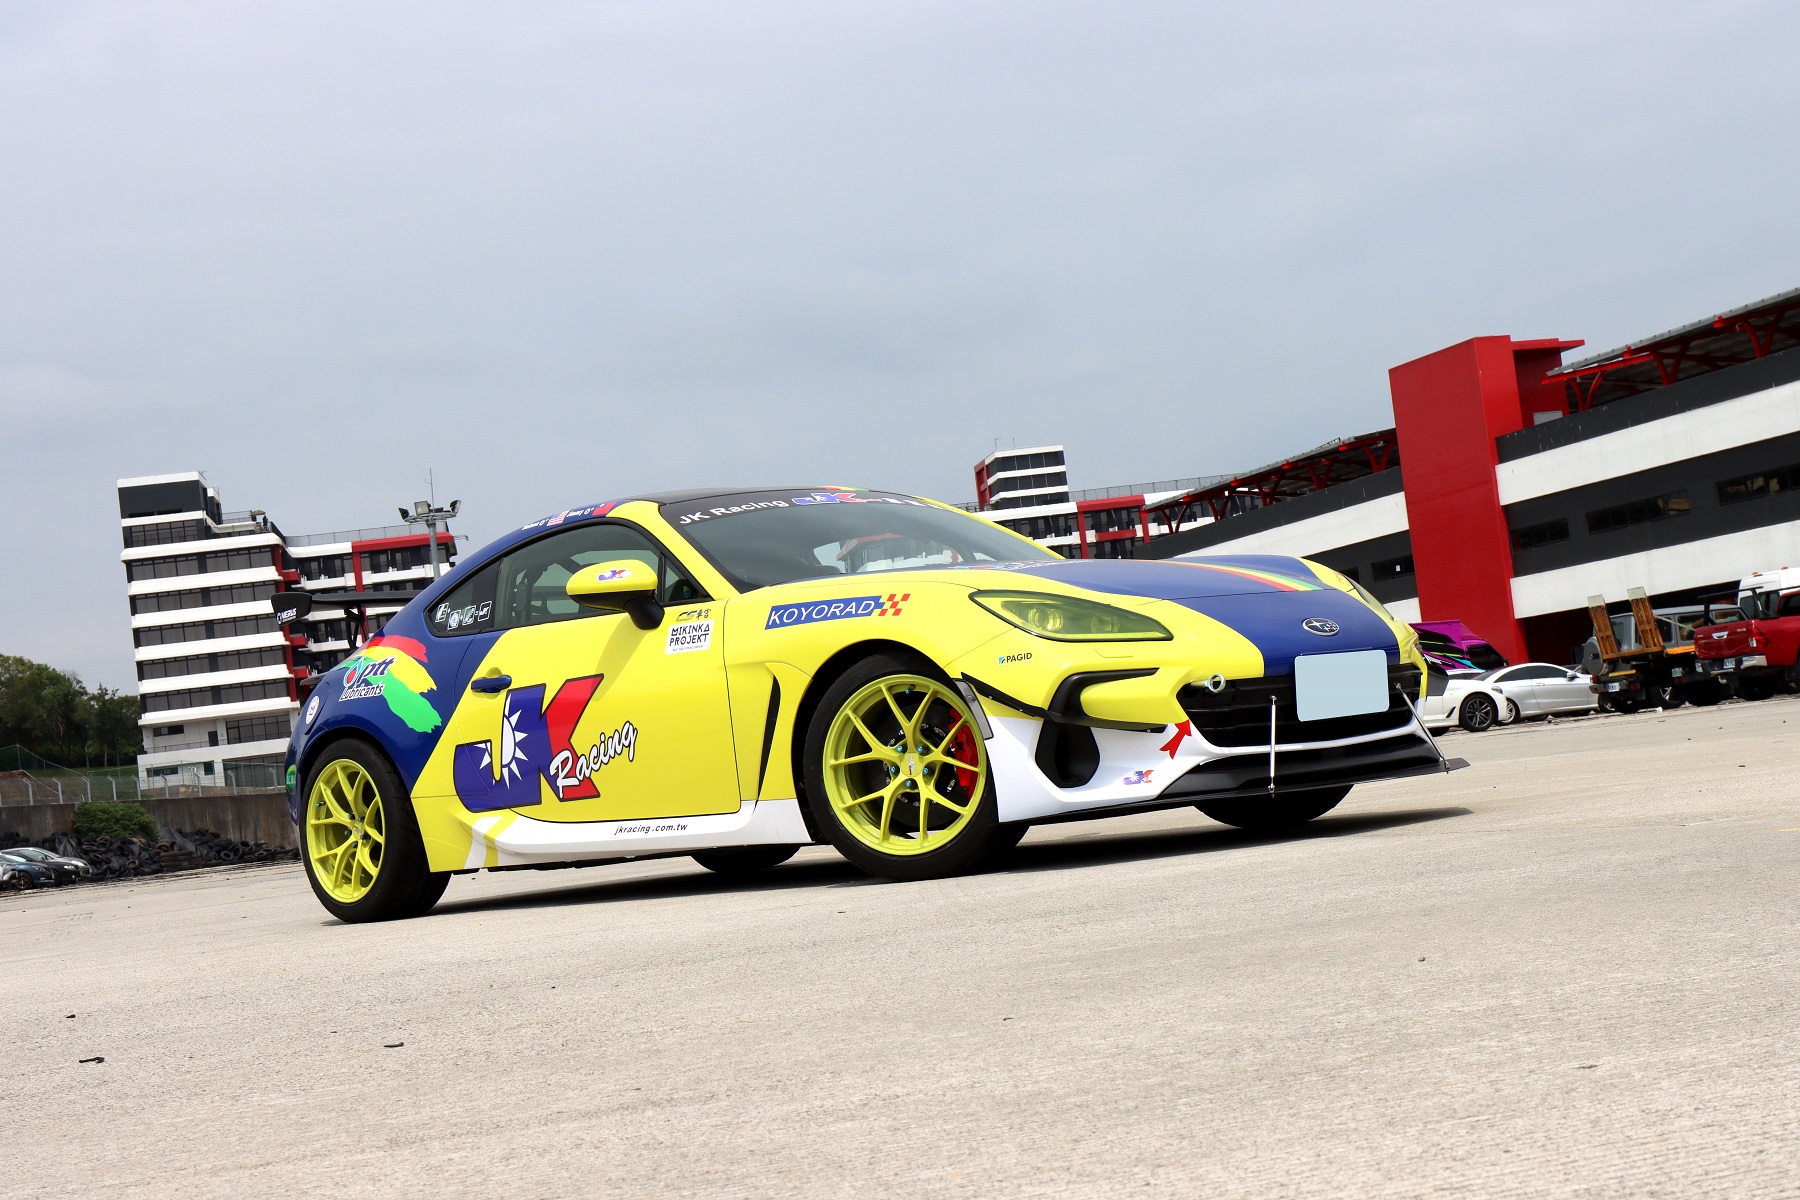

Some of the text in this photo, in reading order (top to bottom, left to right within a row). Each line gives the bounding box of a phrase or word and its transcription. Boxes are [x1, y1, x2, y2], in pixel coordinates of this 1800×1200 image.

[680, 499, 790, 524] JK Racing
[768, 600, 875, 626] KOYORAD
[669, 633, 709, 646] PROJEKT
[671, 623, 710, 637] MIKINKA
[1006, 652, 1033, 663] PAGID
[357, 655, 397, 684] ptt
[339, 682, 385, 701] Lubricants
[549, 720, 638, 800] Racing
